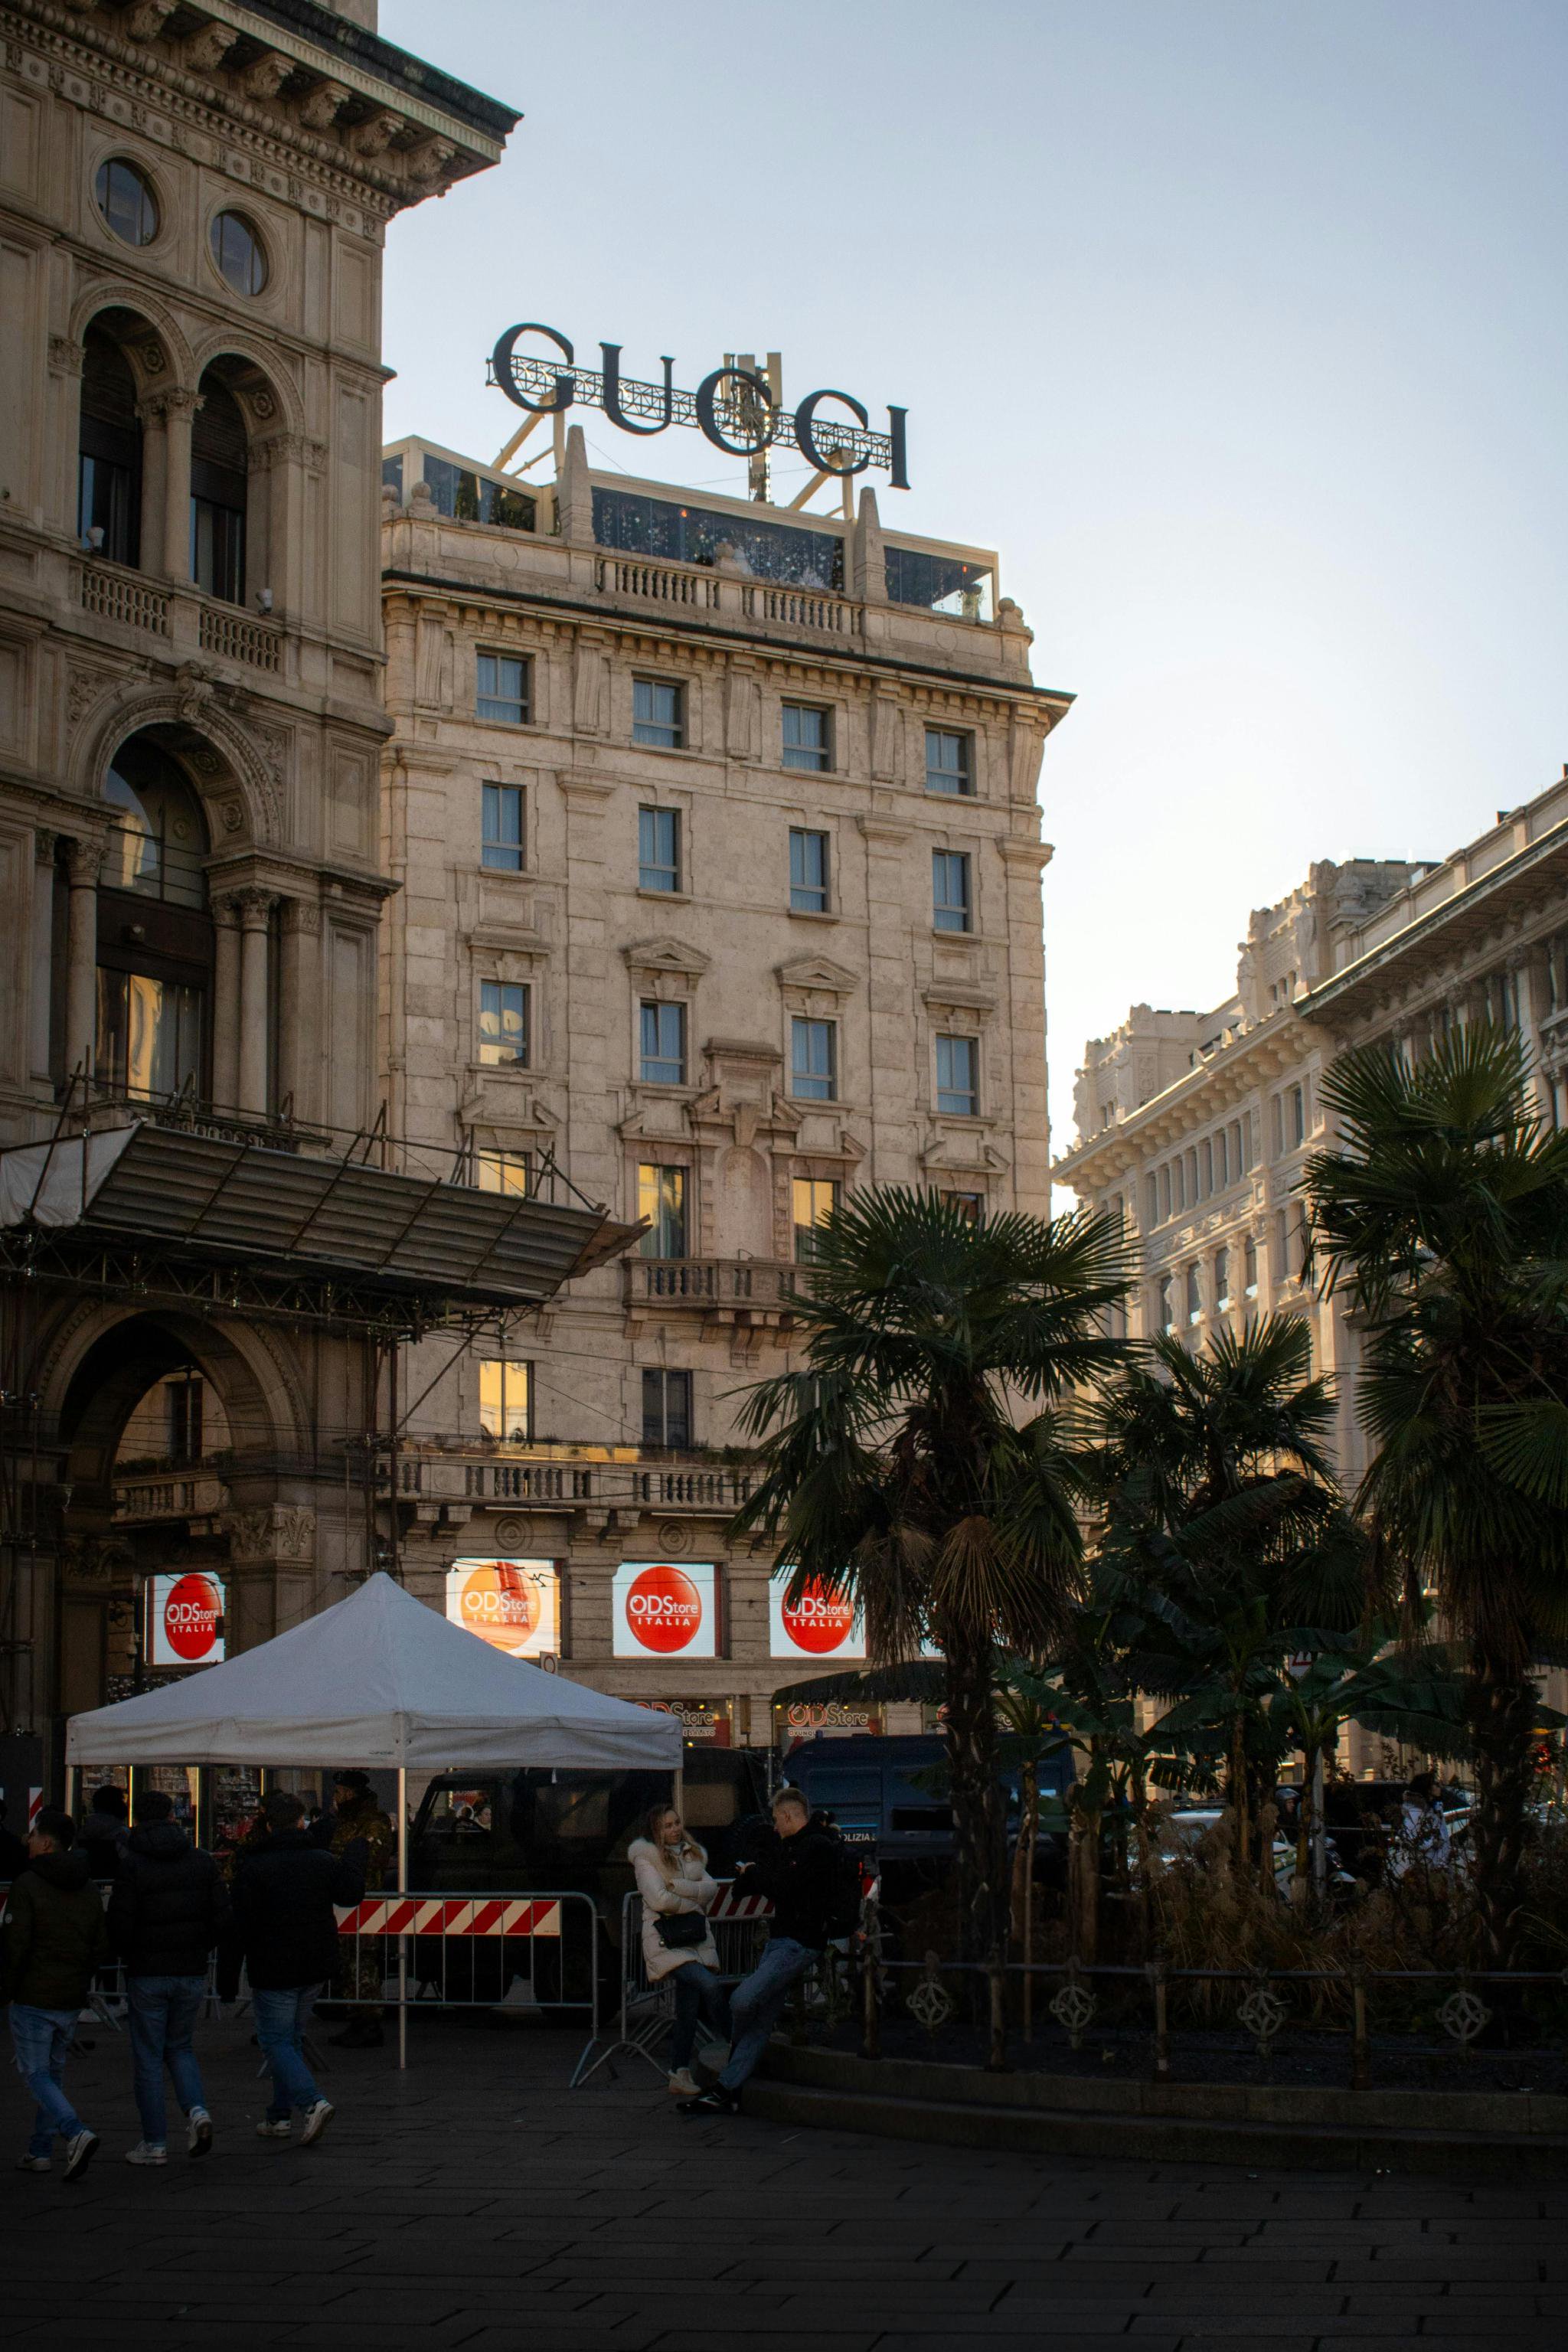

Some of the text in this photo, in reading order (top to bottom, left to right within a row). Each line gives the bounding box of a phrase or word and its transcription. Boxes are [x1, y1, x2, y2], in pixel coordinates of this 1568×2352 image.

[492, 322, 911, 490] GUCCI
[464, 1591, 537, 1612] ODStore
[629, 1595, 699, 1615] ODStore
[166, 1602, 220, 1623] ODStore
[473, 1613, 528, 1622] ITALIA
[172, 1623, 214, 1634] ITALIA
[637, 1617, 691, 1625] ITALIA
[792, 1619, 843, 1627] ITALIA
[788, 1702, 869, 1727] ODStore
[838, 1833, 871, 1842] OLIZIA
